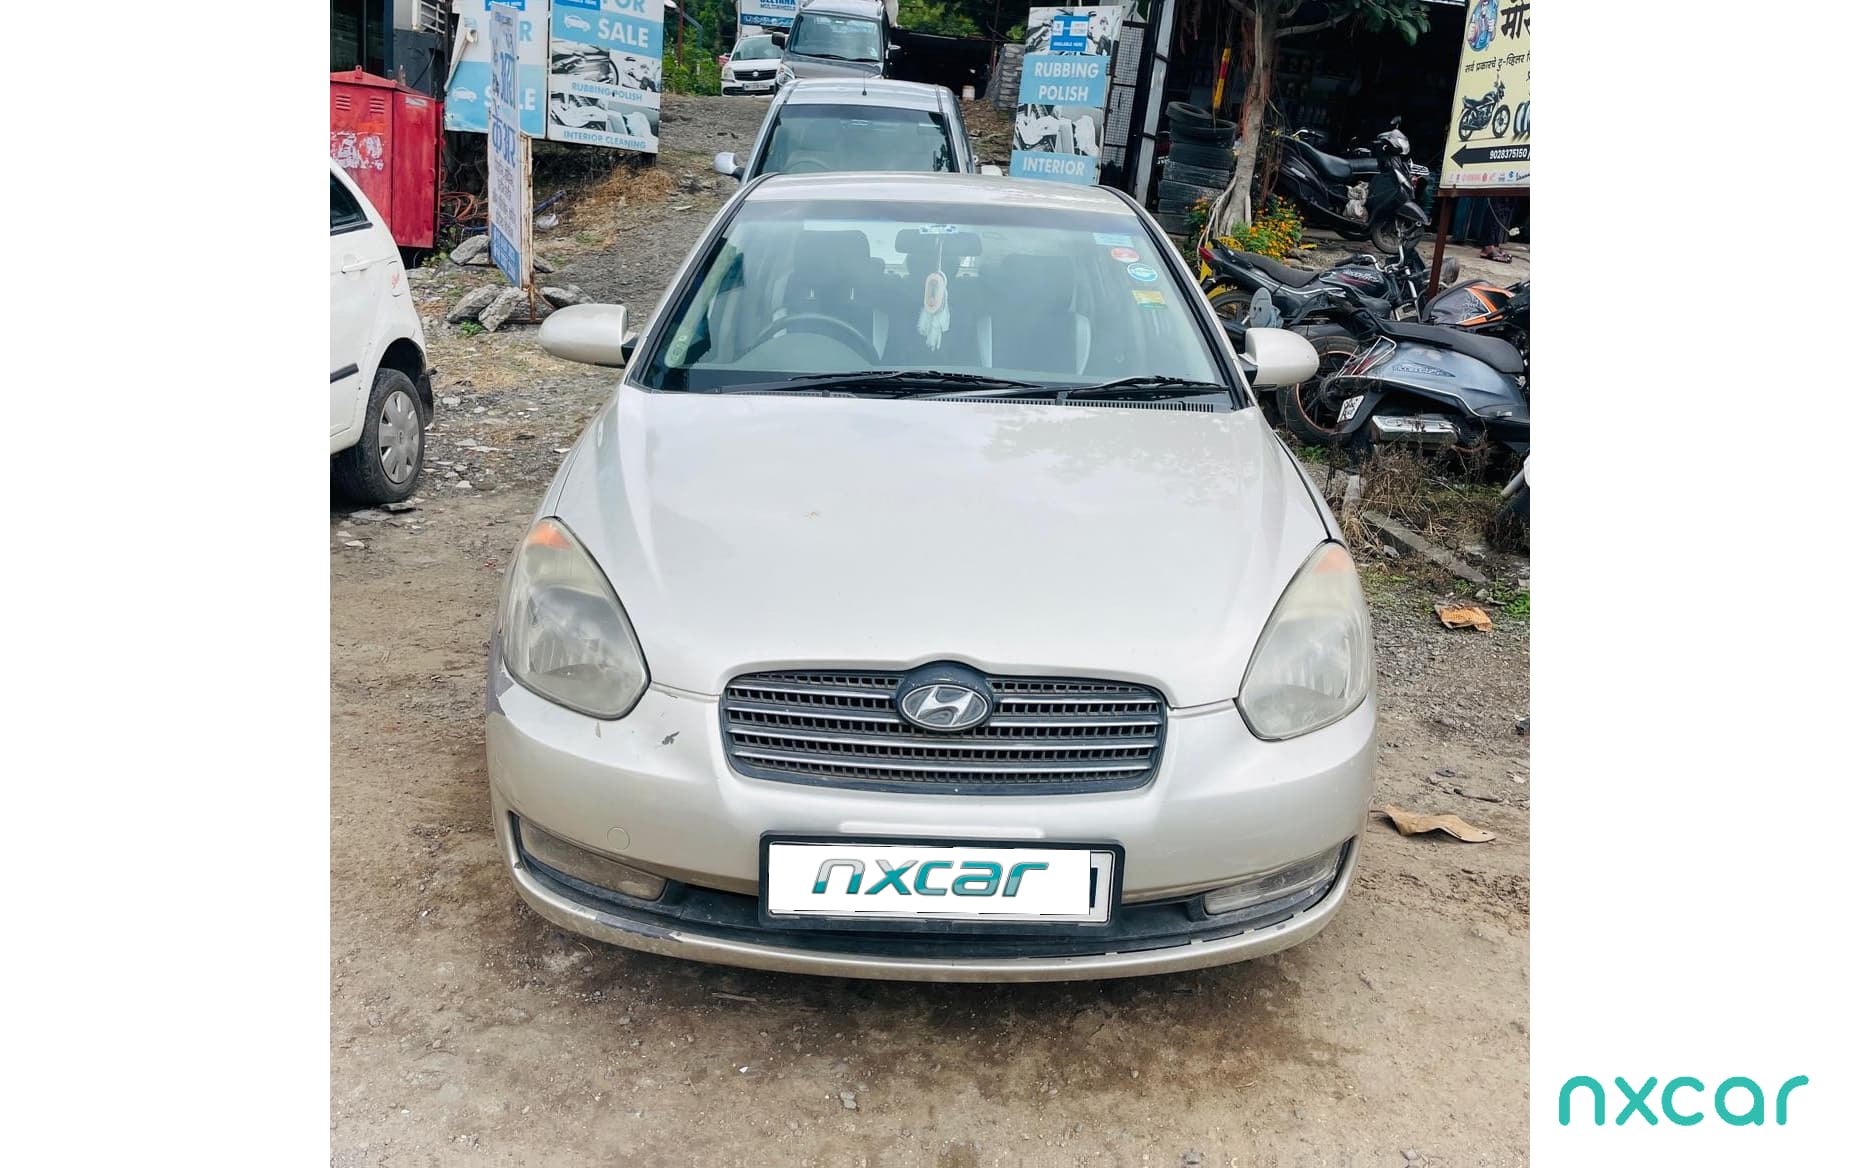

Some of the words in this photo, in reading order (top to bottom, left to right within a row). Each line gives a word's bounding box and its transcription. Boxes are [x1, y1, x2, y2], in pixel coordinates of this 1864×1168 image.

[597, 17, 649, 48] SALE
[1034, 62, 1099, 79] RUBBING
[571, 82, 610, 96] RUBBING
[611, 89, 643, 100] POLISH
[1038, 85, 1089, 101] POLISH
[563, 130, 603, 142] INTERIOR
[605, 135, 646, 149] CLEANING
[1022, 156, 1085, 175] INTERIOR
